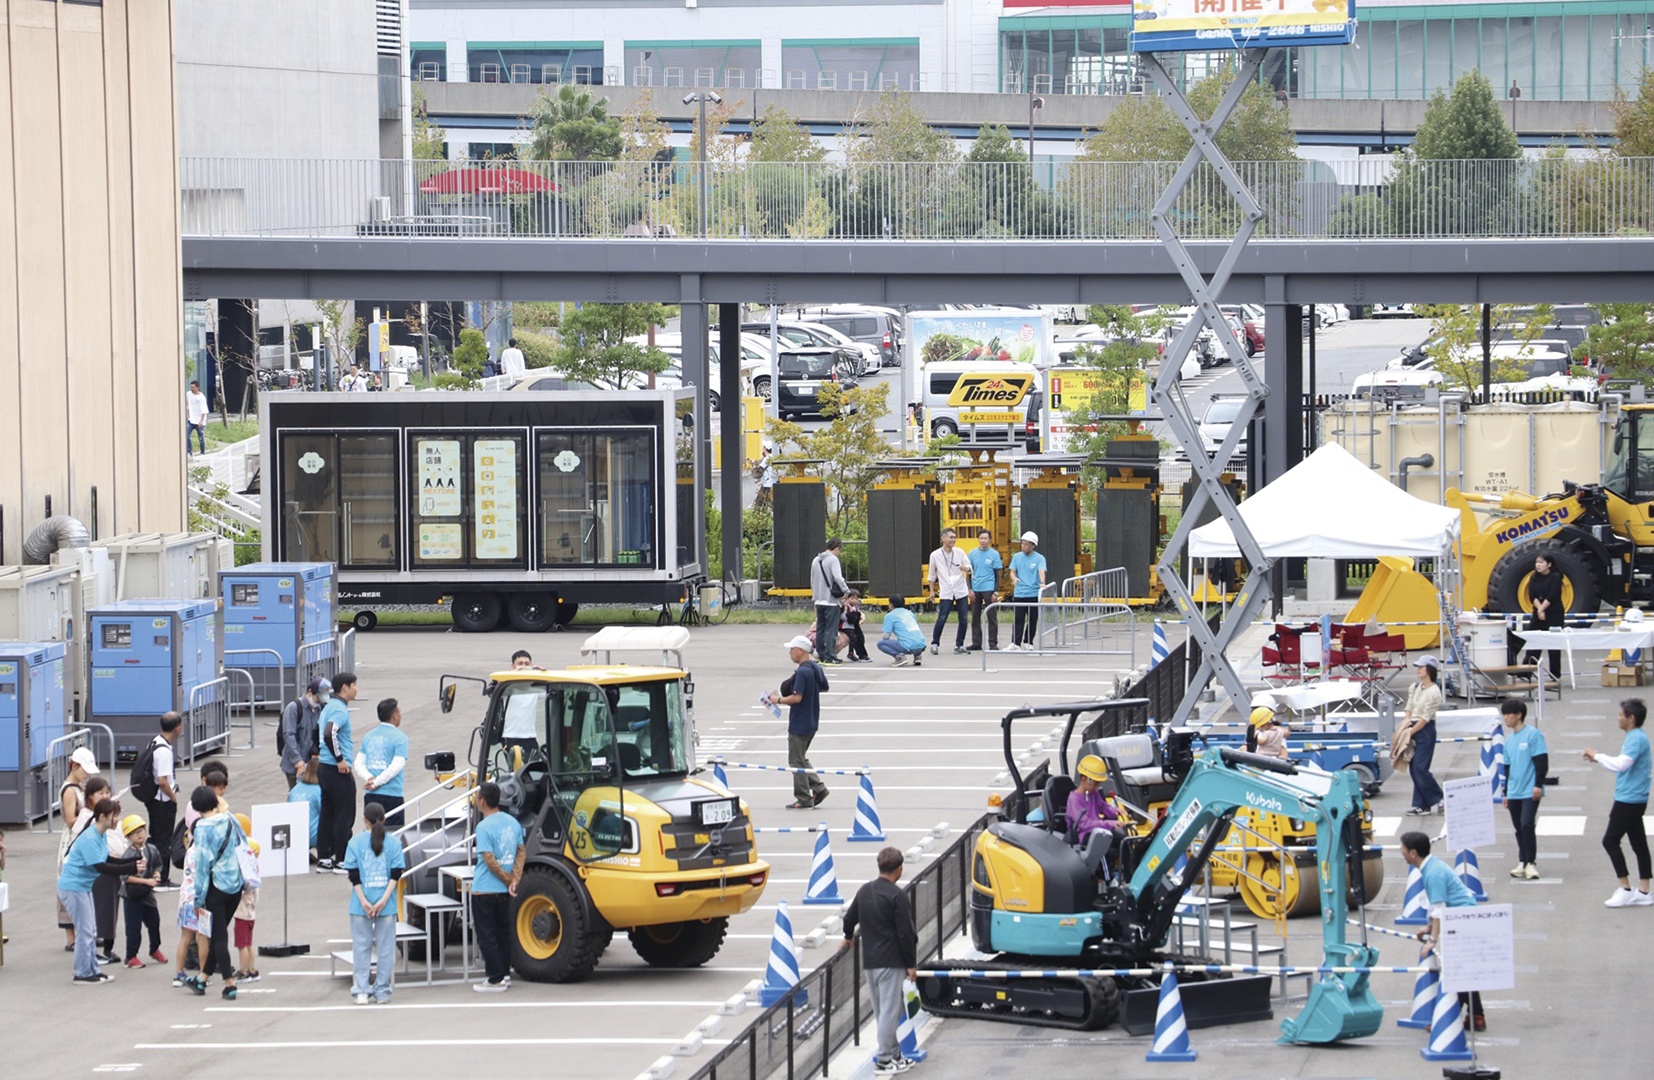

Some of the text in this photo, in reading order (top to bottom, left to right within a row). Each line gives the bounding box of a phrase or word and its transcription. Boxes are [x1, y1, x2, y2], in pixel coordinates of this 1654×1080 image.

[1309, 23, 1345, 33] NISHIO
[962, 385, 1019, 402] Times
[425, 447, 442, 455] 無人
[425, 456, 442, 465] 店舗
[1496, 506, 1569, 544] KOMATSU
[1246, 791, 1283, 812] Kubota
